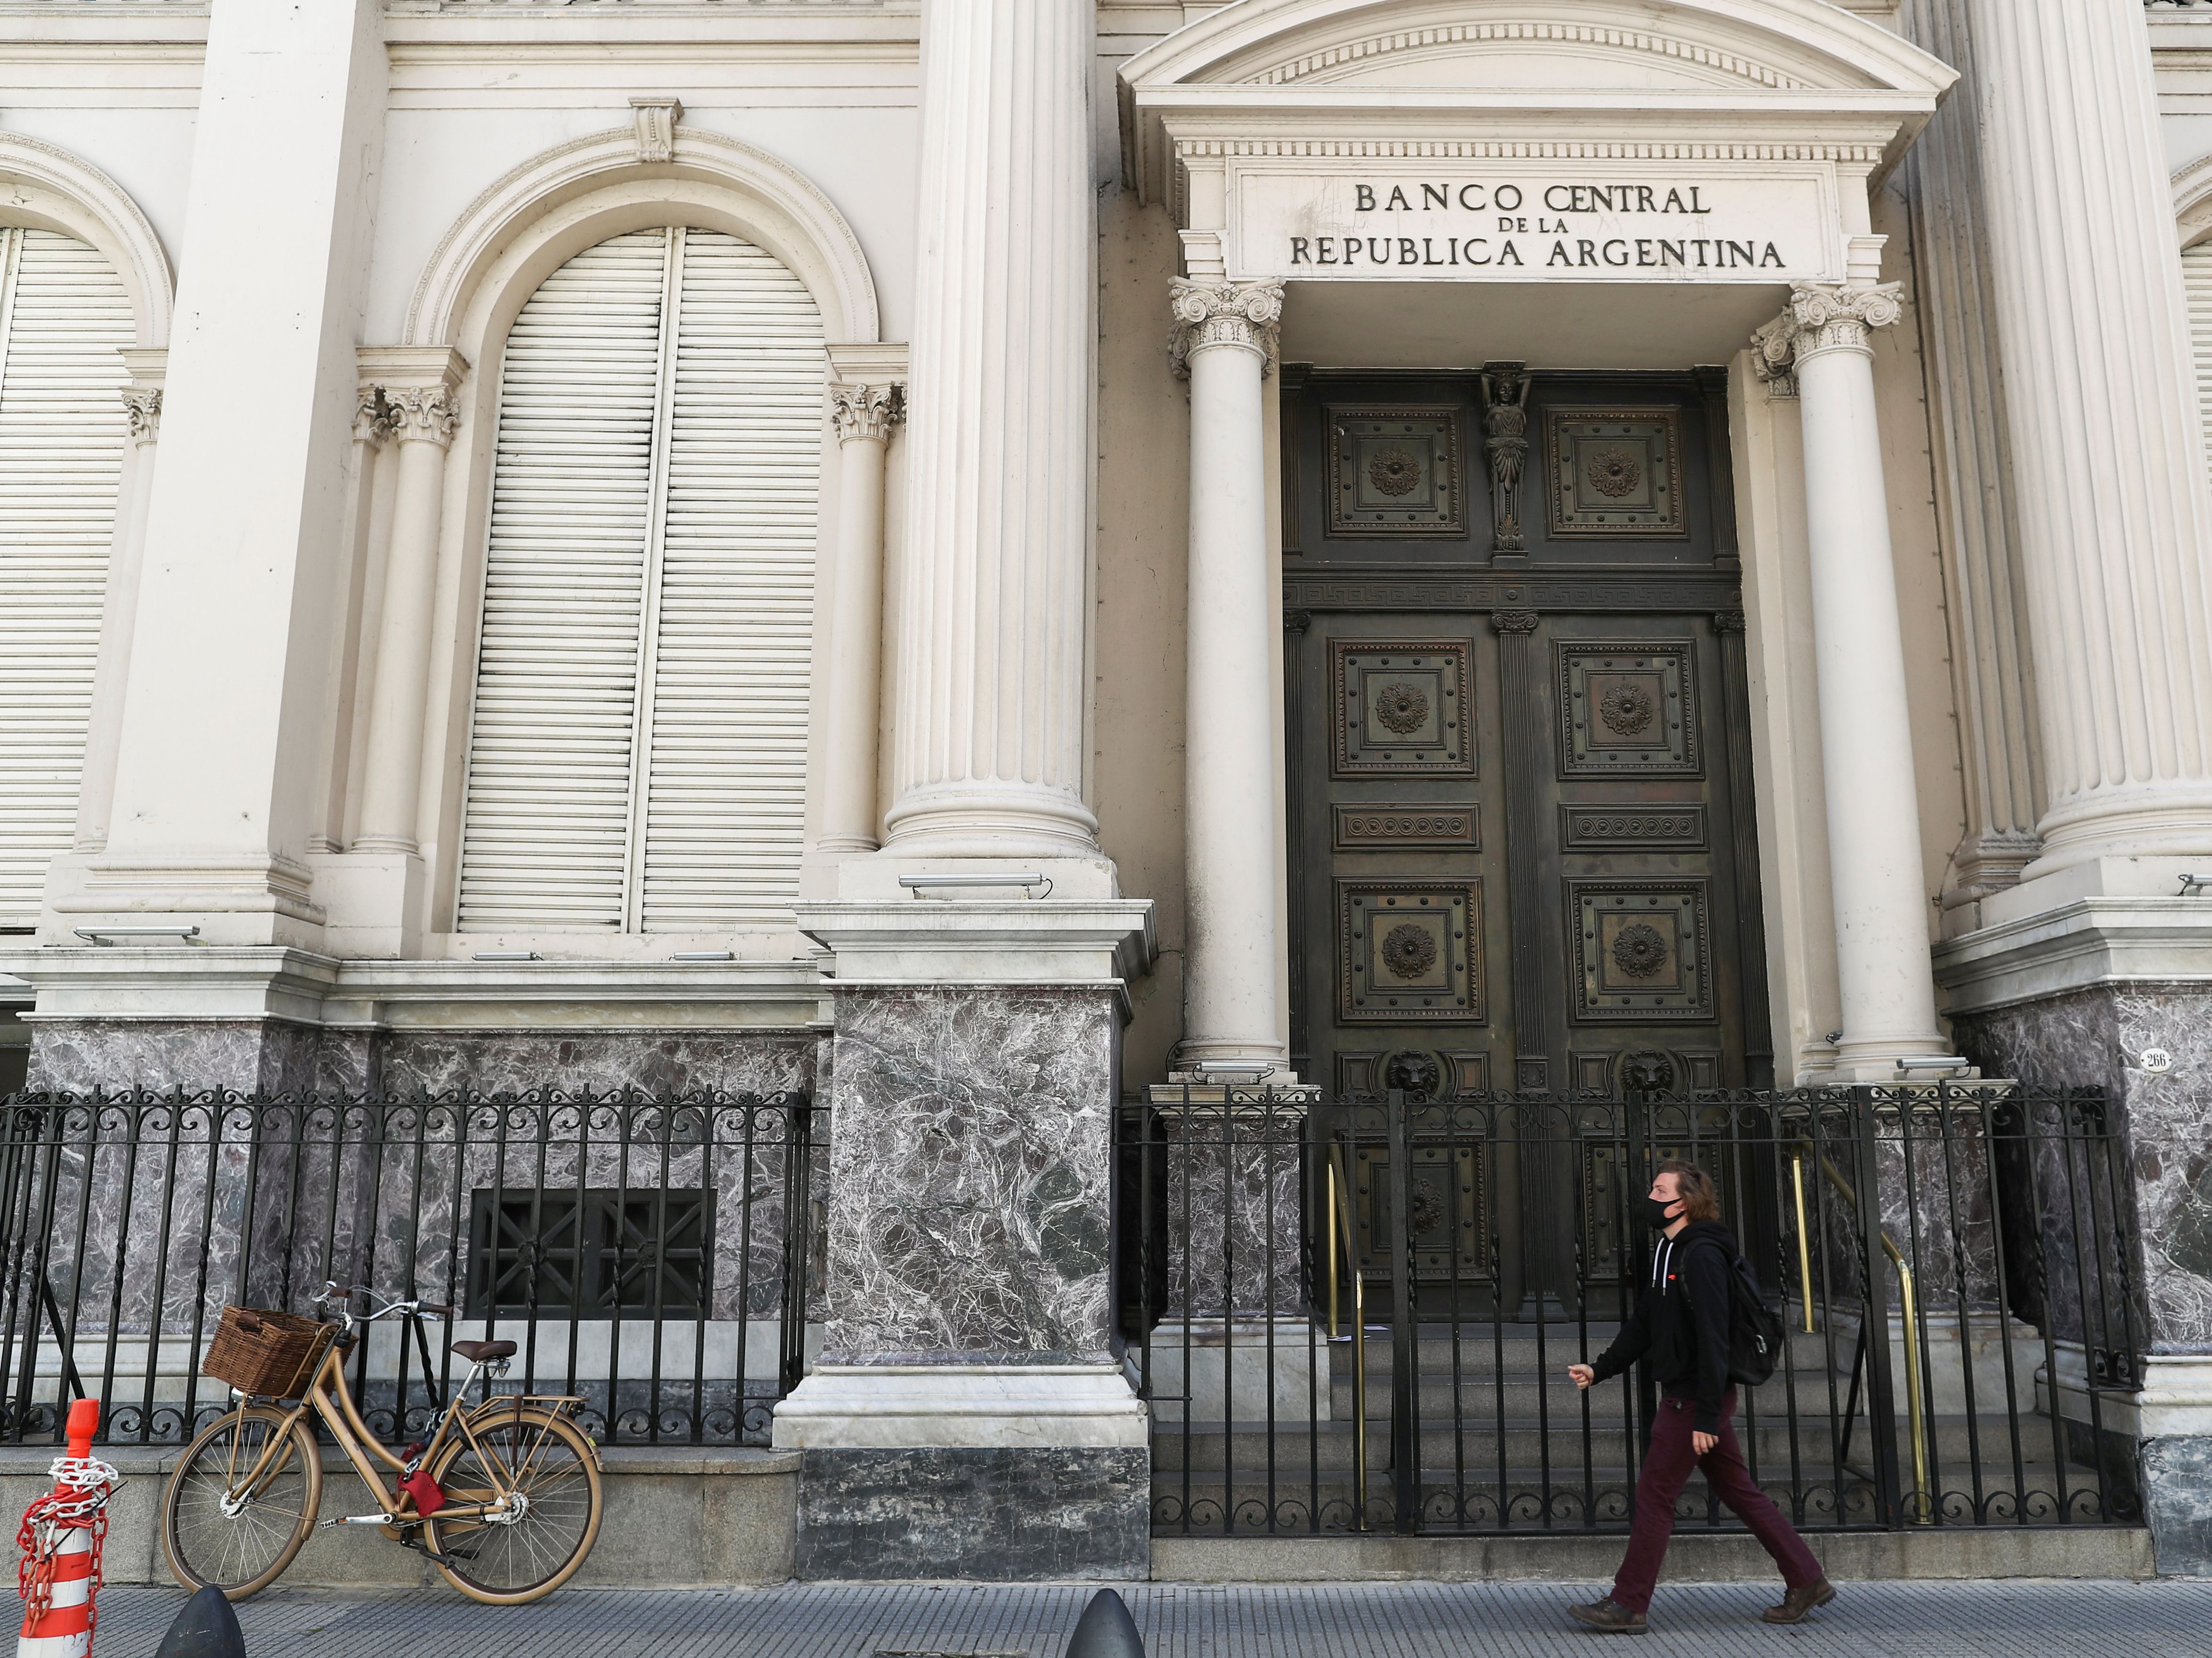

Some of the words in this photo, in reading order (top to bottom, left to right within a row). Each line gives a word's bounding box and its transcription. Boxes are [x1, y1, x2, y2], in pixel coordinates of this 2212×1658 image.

[1355, 184, 1522, 211] BANCO
[1544, 185, 1711, 213] CENTRAL
[1498, 217, 1528, 233] DE
[1539, 218, 1568, 233] LA
[1290, 237, 1524, 266] REPUBLICA
[1546, 239, 1786, 268] ARGENTINA
[2147, 1053, 2166, 1067] 266
